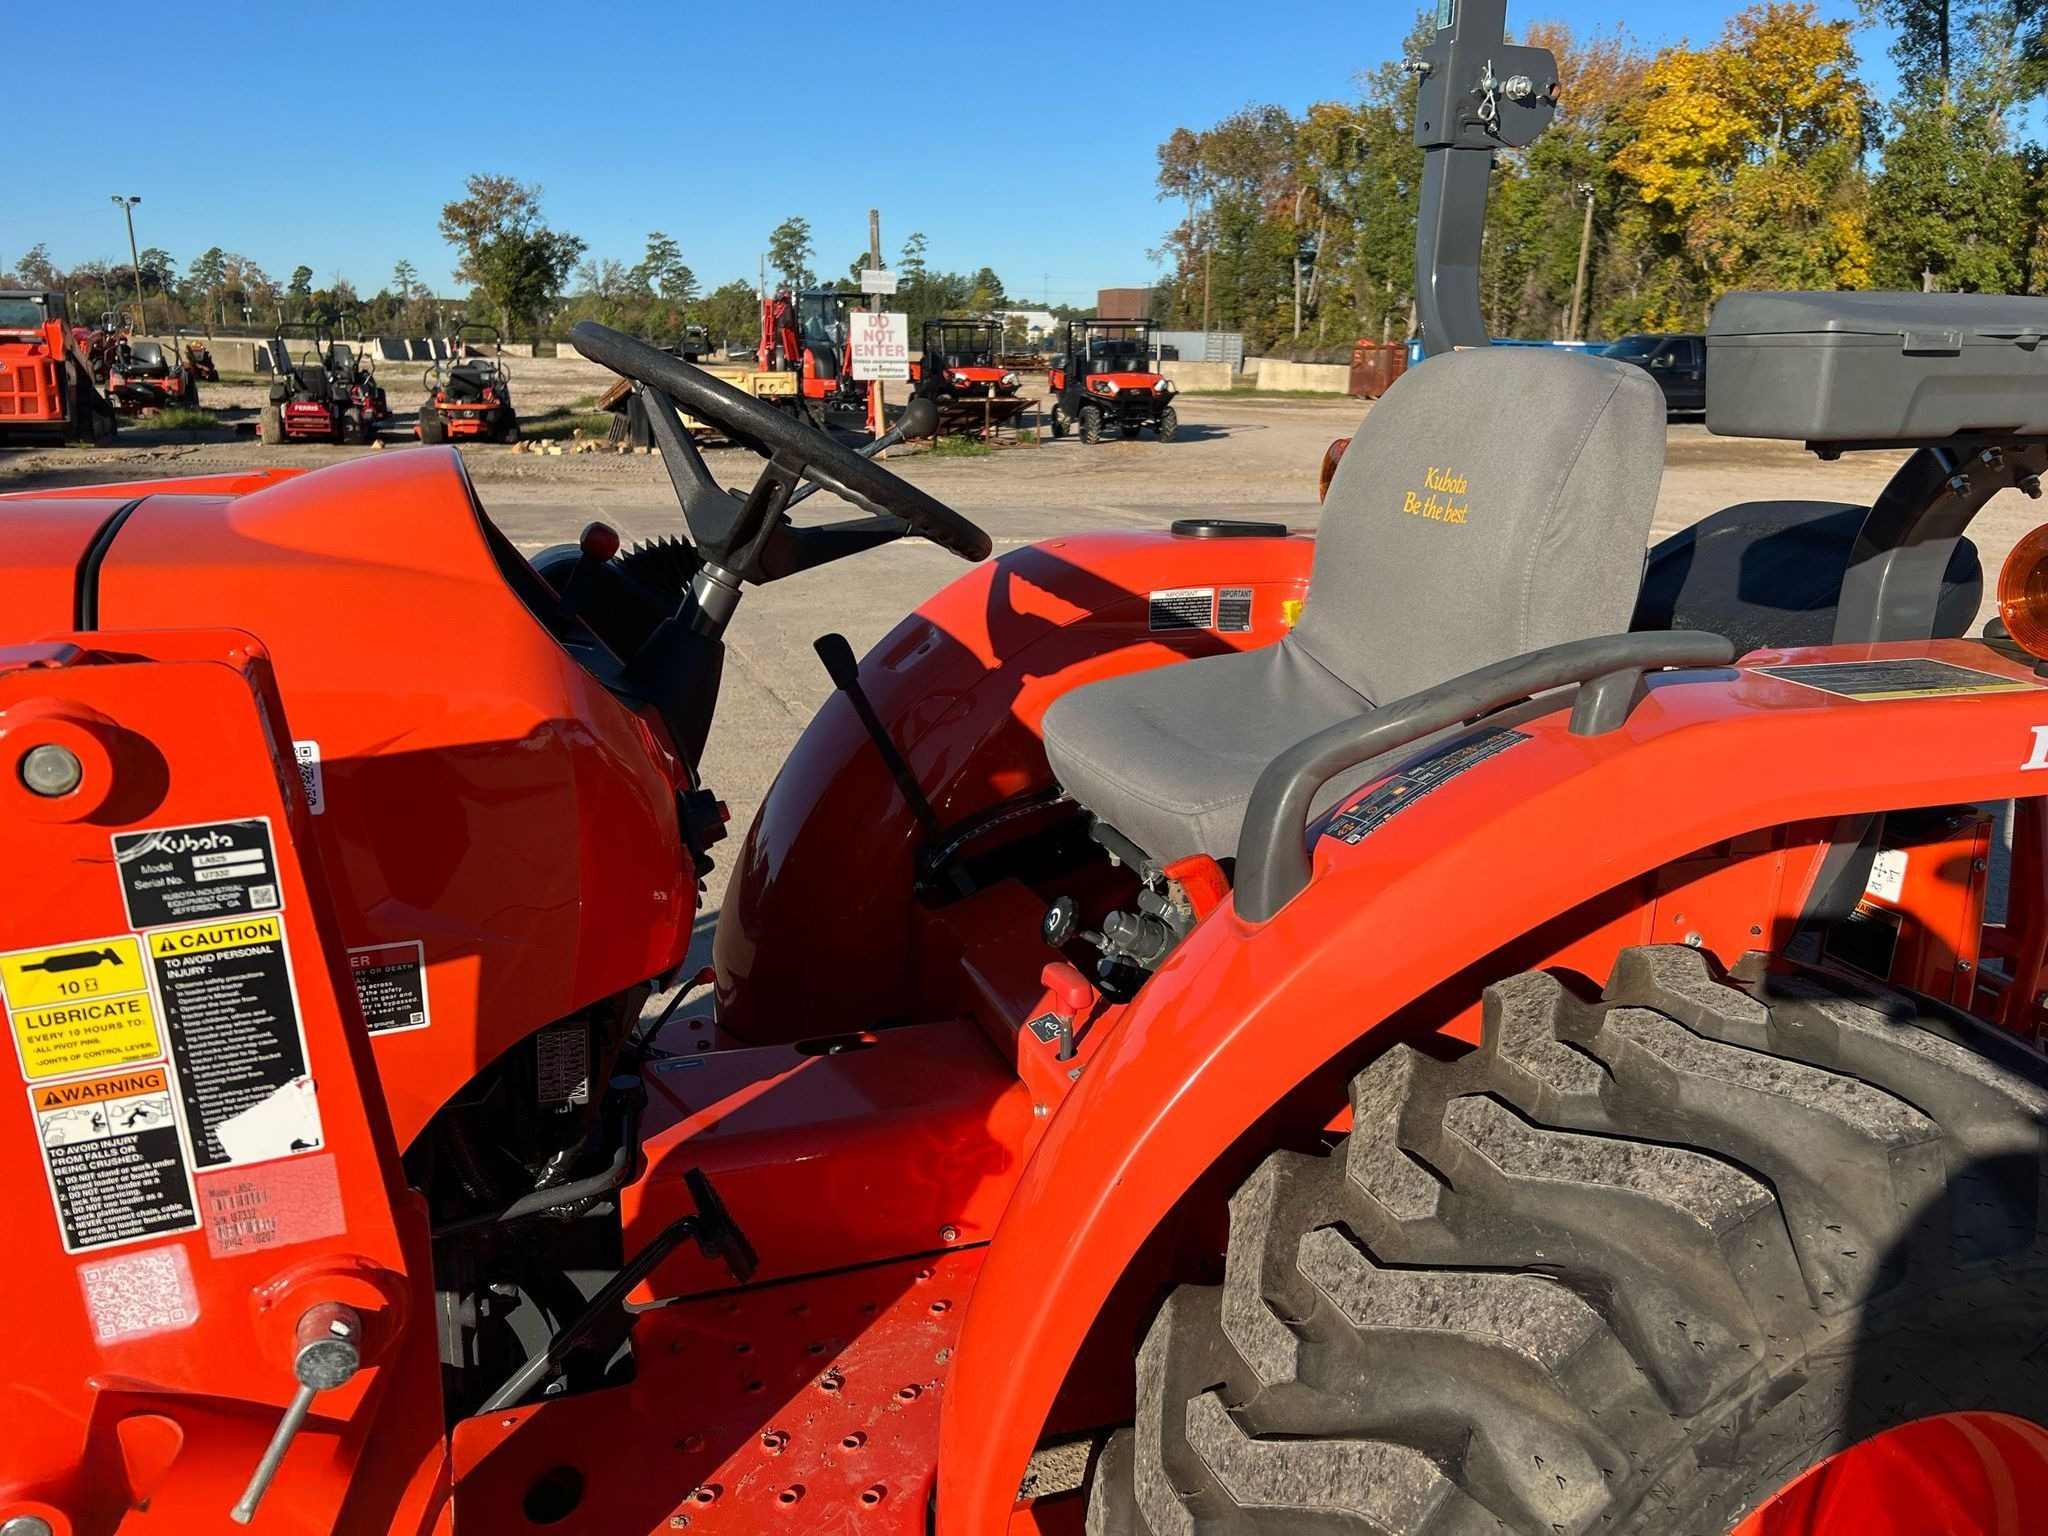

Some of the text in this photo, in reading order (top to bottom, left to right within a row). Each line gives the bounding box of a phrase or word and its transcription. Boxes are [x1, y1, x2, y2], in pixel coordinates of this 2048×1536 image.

[868, 315, 889, 328] DO
[863, 330, 895, 342] NOT
[854, 344, 905, 357] ENTER
[1424, 466, 1468, 495] Kubota
[1403, 491, 1422, 516] Be
[1422, 494, 1443, 520] the
[1220, 590, 1252, 598] IMPORTANT
[155, 831, 234, 854] Kubota
[141, 862, 174, 874] Model
[134, 878, 165, 890] Serial
[166, 876, 184, 885] No.
[162, 885, 244, 900] KUBOTA INDUSTRIAL
[167, 896, 215, 908] EQUIPMENT
[180, 923, 272, 948] CAUTION
[164, 945, 274, 968] TO AVOID PERSONAL
[167, 966, 206, 979] INJURY
[385, 964, 413, 972] DEATH
[58, 981, 80, 995] 10
[26, 1000, 141, 1029] LUBRICATE
[27, 1032, 63, 1043] EVERY
[84, 1022, 123, 1034] HOURS
[54, 1041, 77, 1050] PIVOT
[83, 1048, 122, 1059] CONTROL
[61, 1074, 160, 1101] WARNING
[49, 1135, 138, 1157] TO AVOID INJURY
[52, 1145, 137, 1167] FROM FALLS OR
[54, 1163, 87, 1176] BEING
[65, 1176, 77, 1184] DO
[78, 1172, 95, 1181] NOT
[96, 1168, 119, 1178] stand
[130, 1163, 152, 1172] work
[152, 1159, 176, 1168] under
[67, 1181, 92, 1191] raised
[93, 1177, 119, 1187] loader
[69, 1191, 81, 1199] DO
[82, 1188, 98, 1197] NOT
[116, 1181, 141, 1190] loader
[72, 1206, 84, 1214] DO
[85, 1203, 101, 1211] NOT
[119, 1196, 144, 1205] loader
[74, 1213, 95, 1221] work
[76, 1218, 102, 1229] NEVER
[103, 1212, 135, 1224] connect
[117, 1219, 142, 1229] loader
[143, 1213, 171, 1224] bucket
[79, 1232, 118, 1244] operating
